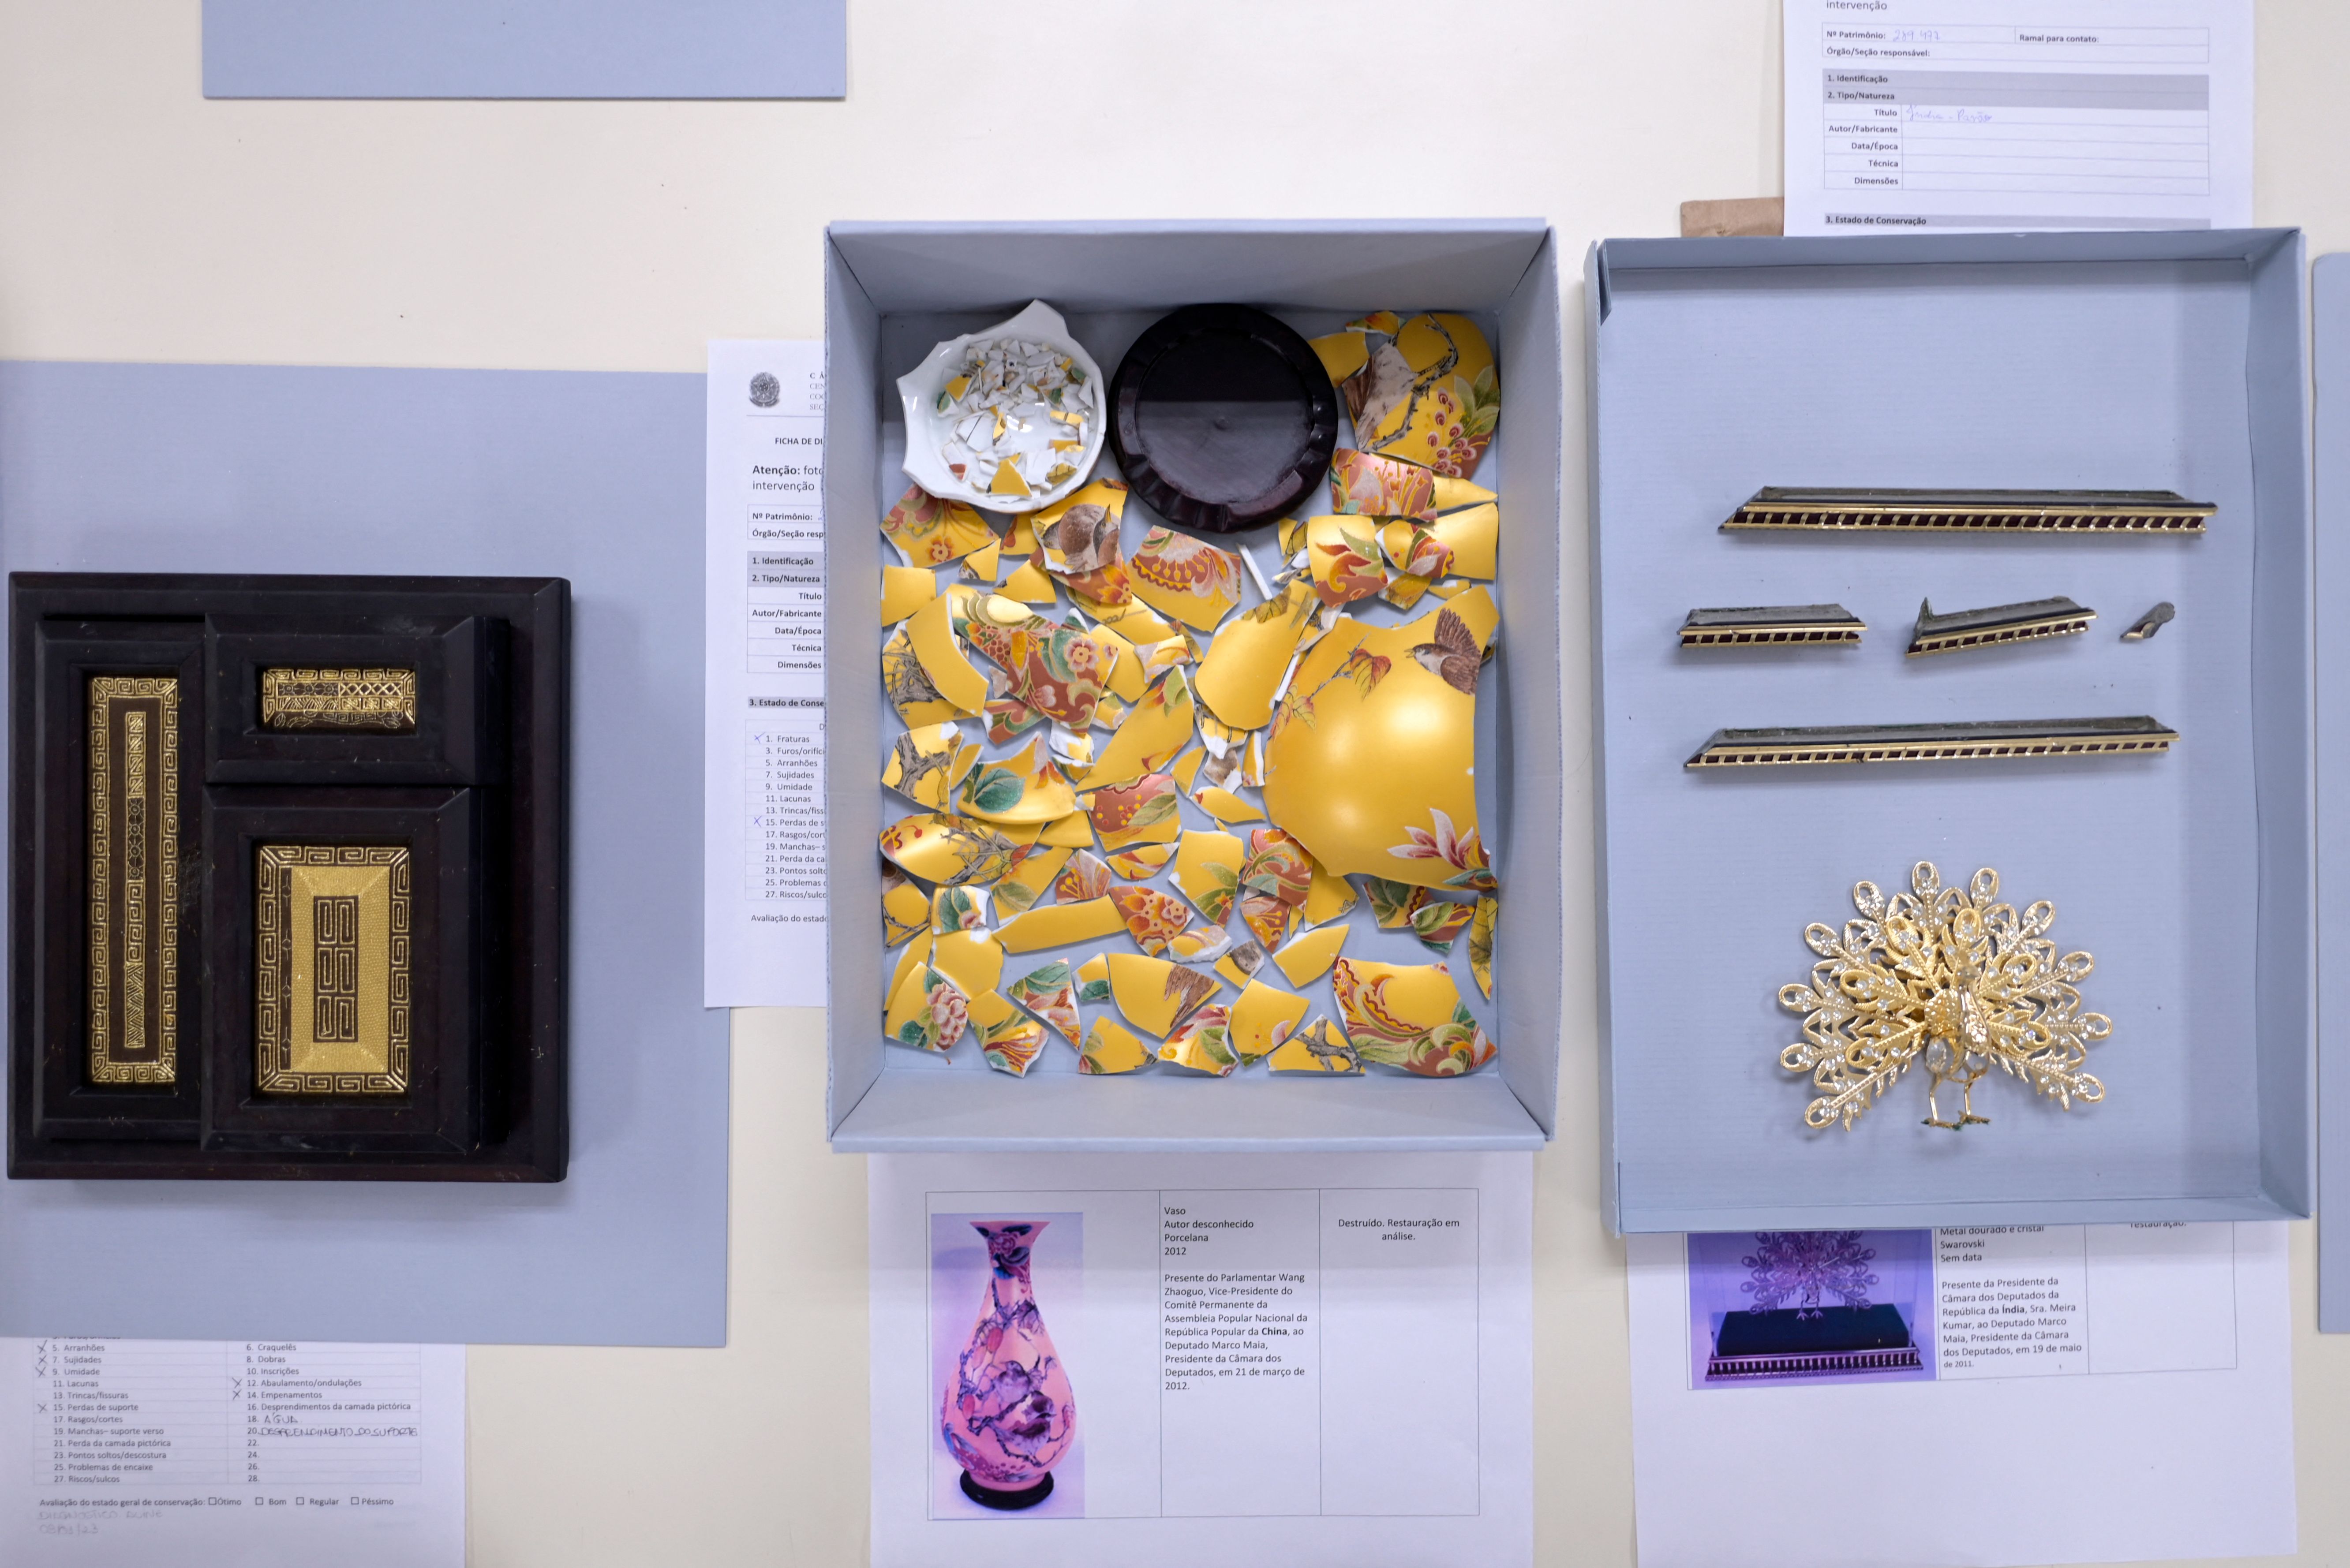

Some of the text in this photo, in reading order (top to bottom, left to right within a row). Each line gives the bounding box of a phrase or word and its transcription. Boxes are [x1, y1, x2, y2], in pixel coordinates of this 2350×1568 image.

[1826, 0, 1887, 12] intervenção
[1826, 46, 1930, 58] Órgão/Seção responsável:
[1837, 75, 1888, 84] Identificação
[1837, 91, 1895, 100] Tipo/Natureza
[1829, 125, 1898, 134] Autor/Fabricante
[1851, 142, 1898, 151] Data/Época
[1876, 217, 1927, 226] Conservação
[752, 465, 800, 477] Atenção:
[753, 480, 815, 493] intervenção
[752, 528, 805, 539] Órgão/Seção
[762, 557, 814, 567] Identificação
[762, 574, 820, 583] Tipo/Natureza
[752, 609, 822, 618] Autor/Fabricante
[775, 626, 822, 636] Data/Época
[777, 771, 814, 780] Sujidades
[1164, 1219, 1254, 1228] Autor desconhecido
[1339, 1218, 1385, 1227] Destruído.
[1388, 1218, 1443, 1229] Restauração
[1382, 1232, 1415, 1240] análise.
[1940, 1227, 1966, 1236] Metal
[1165, 1233, 1209, 1242] Porcelana
[1940, 1239, 1985, 1249] Swarovski
[1164, 1247, 1186, 1255] 2012
[1940, 1253, 1982, 1262] Sem data
[1165, 1273, 1305, 1283] Presente do Parlamentar Wang
[1942, 1277, 2058, 1289] Presente da Presidente da
[1164, 1286, 1293, 1297] Zhaoguo, Vice-Presidente do
[1942, 1290, 2059, 1303] Câmara dos Deputados da
[1164, 1300, 1268, 1309] Comitê Permanente da
[1942, 1307, 1986, 1318] República
[1988, 1306, 1999, 1314] da
[2002, 1304, 2028, 1314] Índia,
[1164, 1313, 1307, 1324] Assembleia Popular Nacional da
[1943, 1322, 1975, 1330] Kumar,
[1991, 1318, 2035, 1329] Deputado
[2038, 1318, 2066, 1326] Marco
[1165, 1328, 1208, 1338] República
[1211, 1327, 1246, 1337] Popular
[1248, 1327, 1259, 1336] da
[1261, 1327, 1290, 1337] China,
[1943, 1331, 2069, 1344] Maia, Presidente da Câmara
[1165, 1340, 1268, 1351] Deputado Marco Maia,
[1943, 1348, 1959, 1357] dos
[1962, 1346, 2013, 1357] Deputados,
[2033, 1344, 2043, 1353] 19
[2046, 1344, 2057, 1352] de
[2060, 1344, 2082, 1352] maio
[1165, 1354, 1281, 1363] Presidente da Câmara dos
[261, 1367, 299, 1376] Inscrições
[1165, 1367, 1216, 1378] Deputados,
[1235, 1368, 1246, 1376] 21
[1249, 1367, 1260, 1376] de
[1263, 1369, 1291, 1378] março
[1294, 1367, 1305, 1375] de
[261, 1379, 362, 1389] Abaulamento/ondulações
[1165, 1381, 1190, 1390] 2012.
[67, 1391, 129, 1400] Trincas/fissuras
[261, 1391, 322, 1400] Empenamentos
[261, 1403, 331, 1413] Desprendimentos
[377, 1403, 411, 1411] pictórica
[39, 1498, 78, 1508] Avaliação
[120, 1499, 140, 1508] geral
[154, 1498, 206, 1507] conservação:
[217, 1497, 242, 1506] Ótimo
[310, 1498, 339, 1507] Regular
